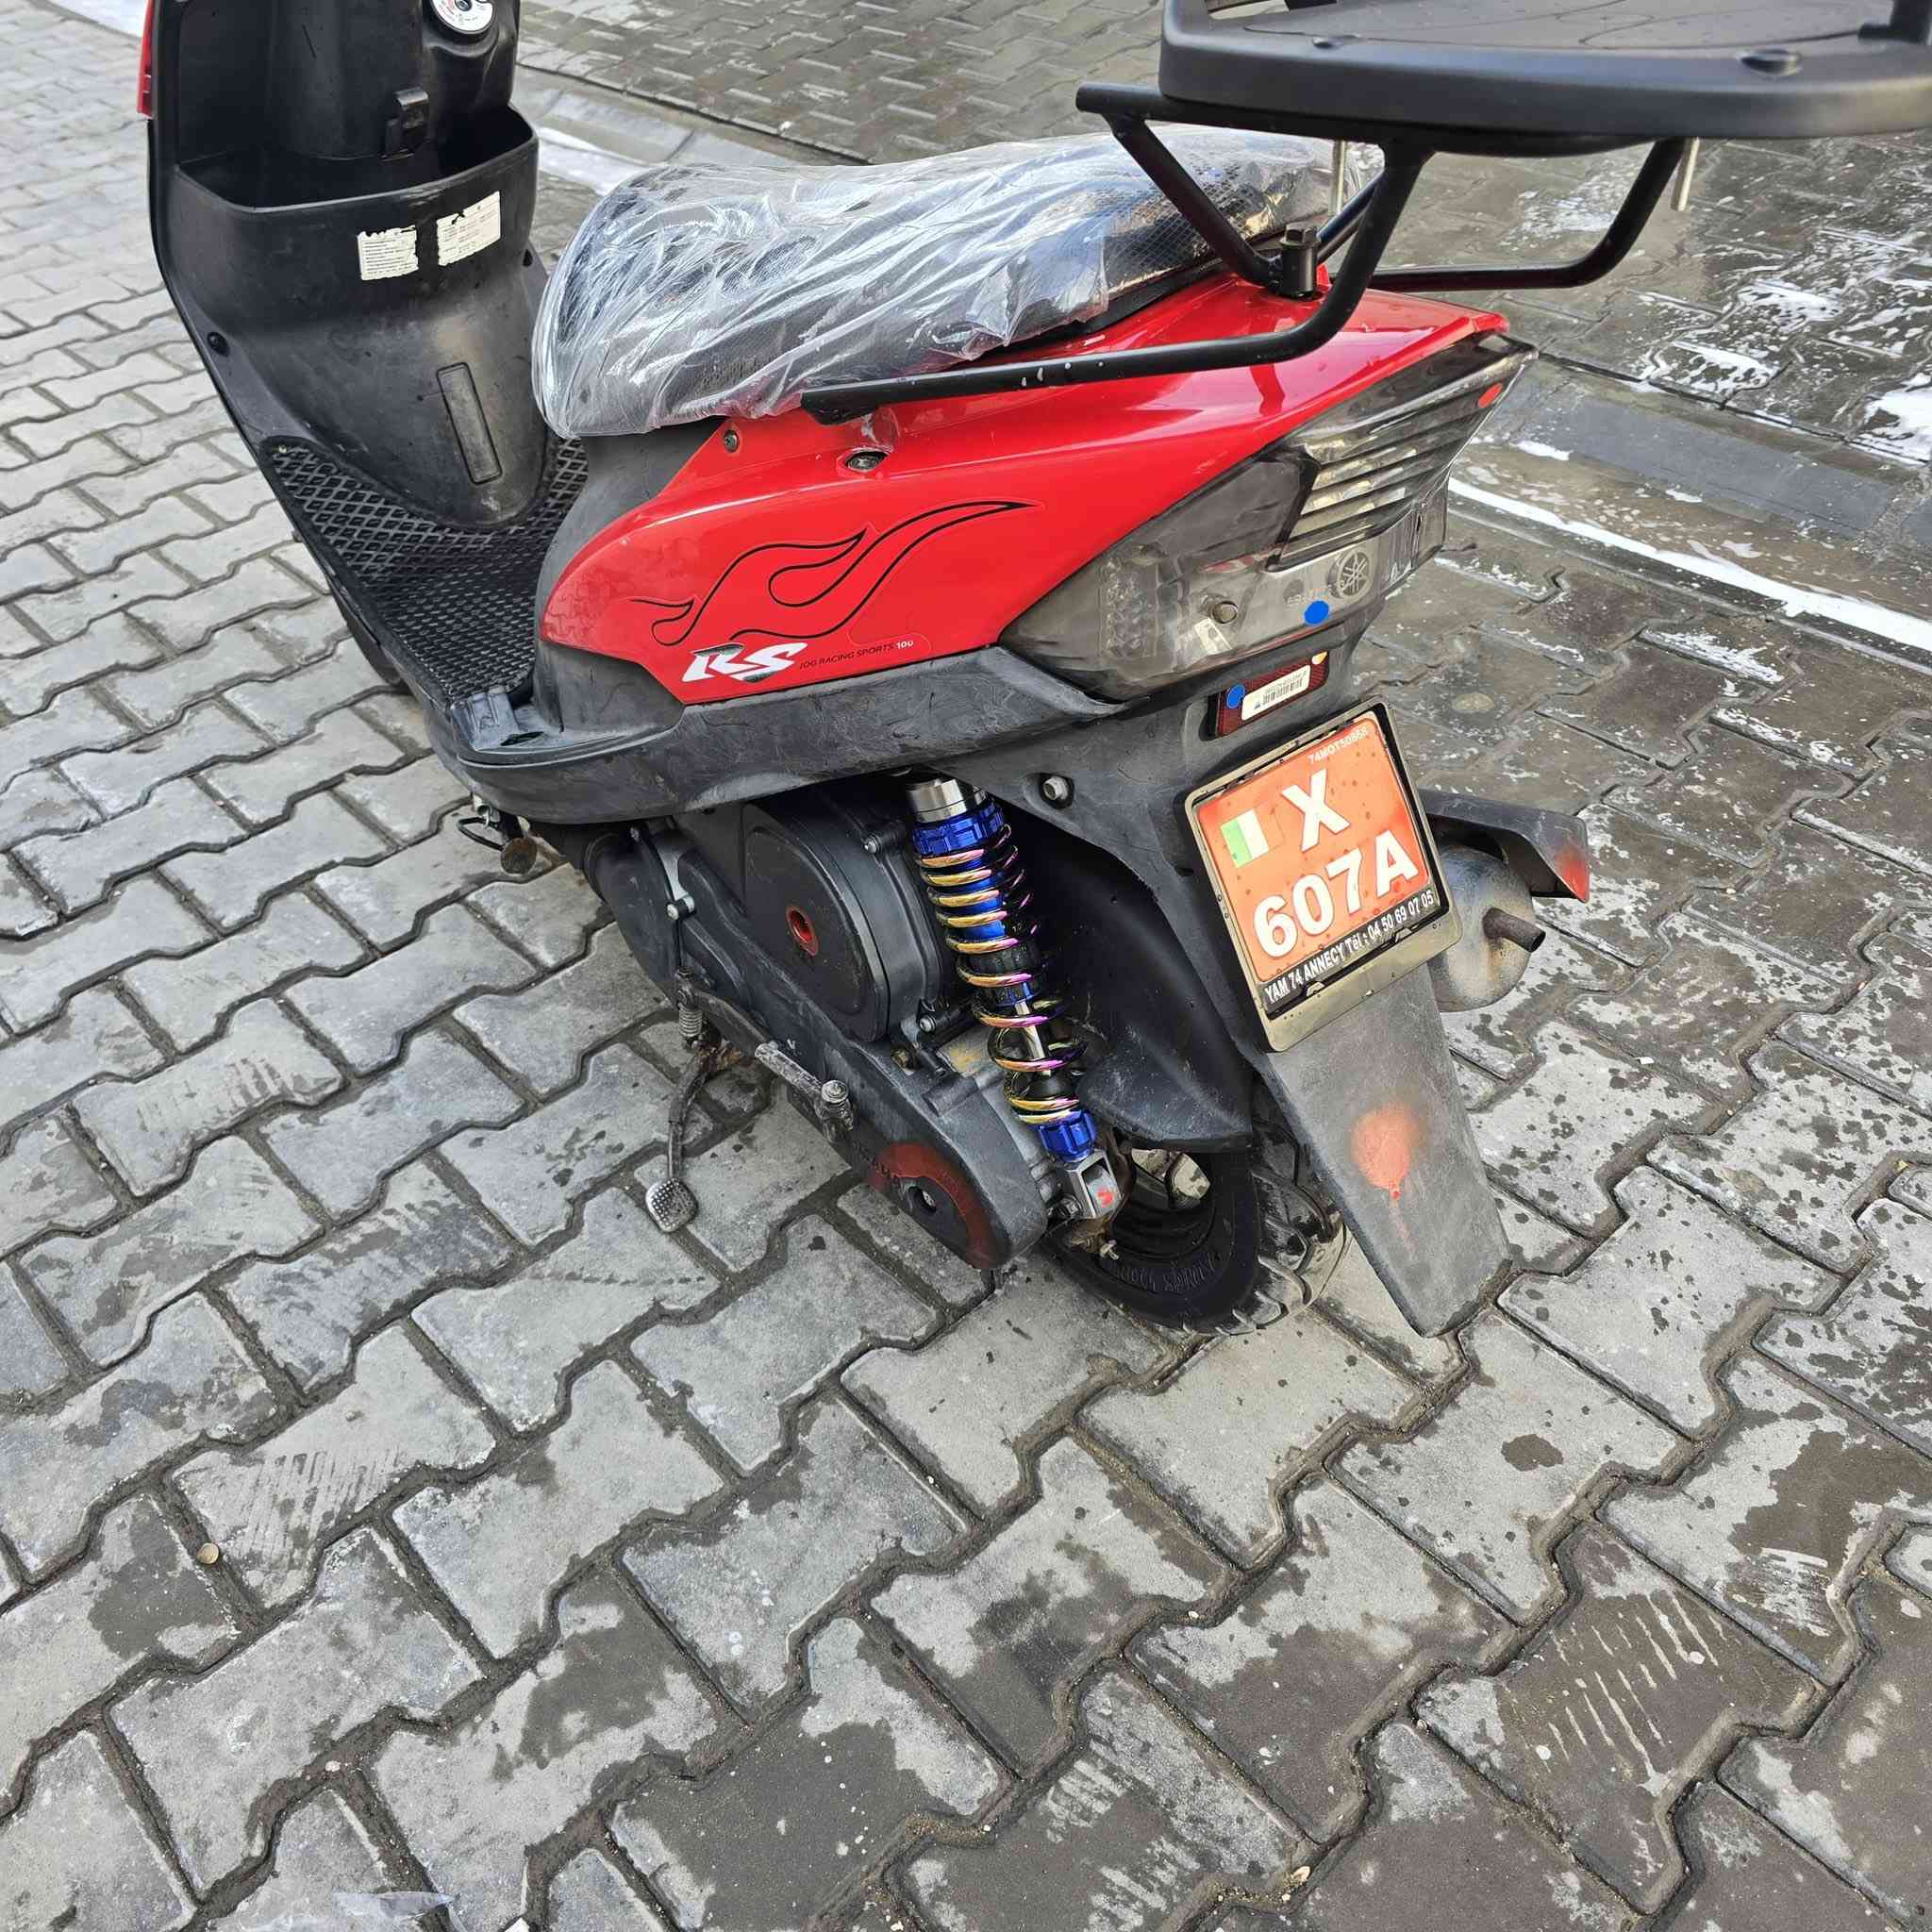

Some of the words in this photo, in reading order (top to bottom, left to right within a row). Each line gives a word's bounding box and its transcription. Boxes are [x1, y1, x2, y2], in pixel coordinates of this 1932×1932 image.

[681, 642, 808, 683] RS
[819, 652, 856, 666] RACING
[856, 643, 894, 658] SPORTS
[895, 641, 914, 650] 100
[1281, 769, 1351, 852] X
[1253, 829, 1419, 958] 607A
[1265, 977, 1290, 1004] YAM
[1288, 968, 1304, 990] 74
[1304, 946, 1344, 982] ANNECY
[1367, 920, 1382, 941] 04
[1380, 913, 1394, 932] 50
[1395, 906, 1407, 924] 69
[1407, 896, 1421, 915] 07
[1421, 890, 1434, 908] 05
